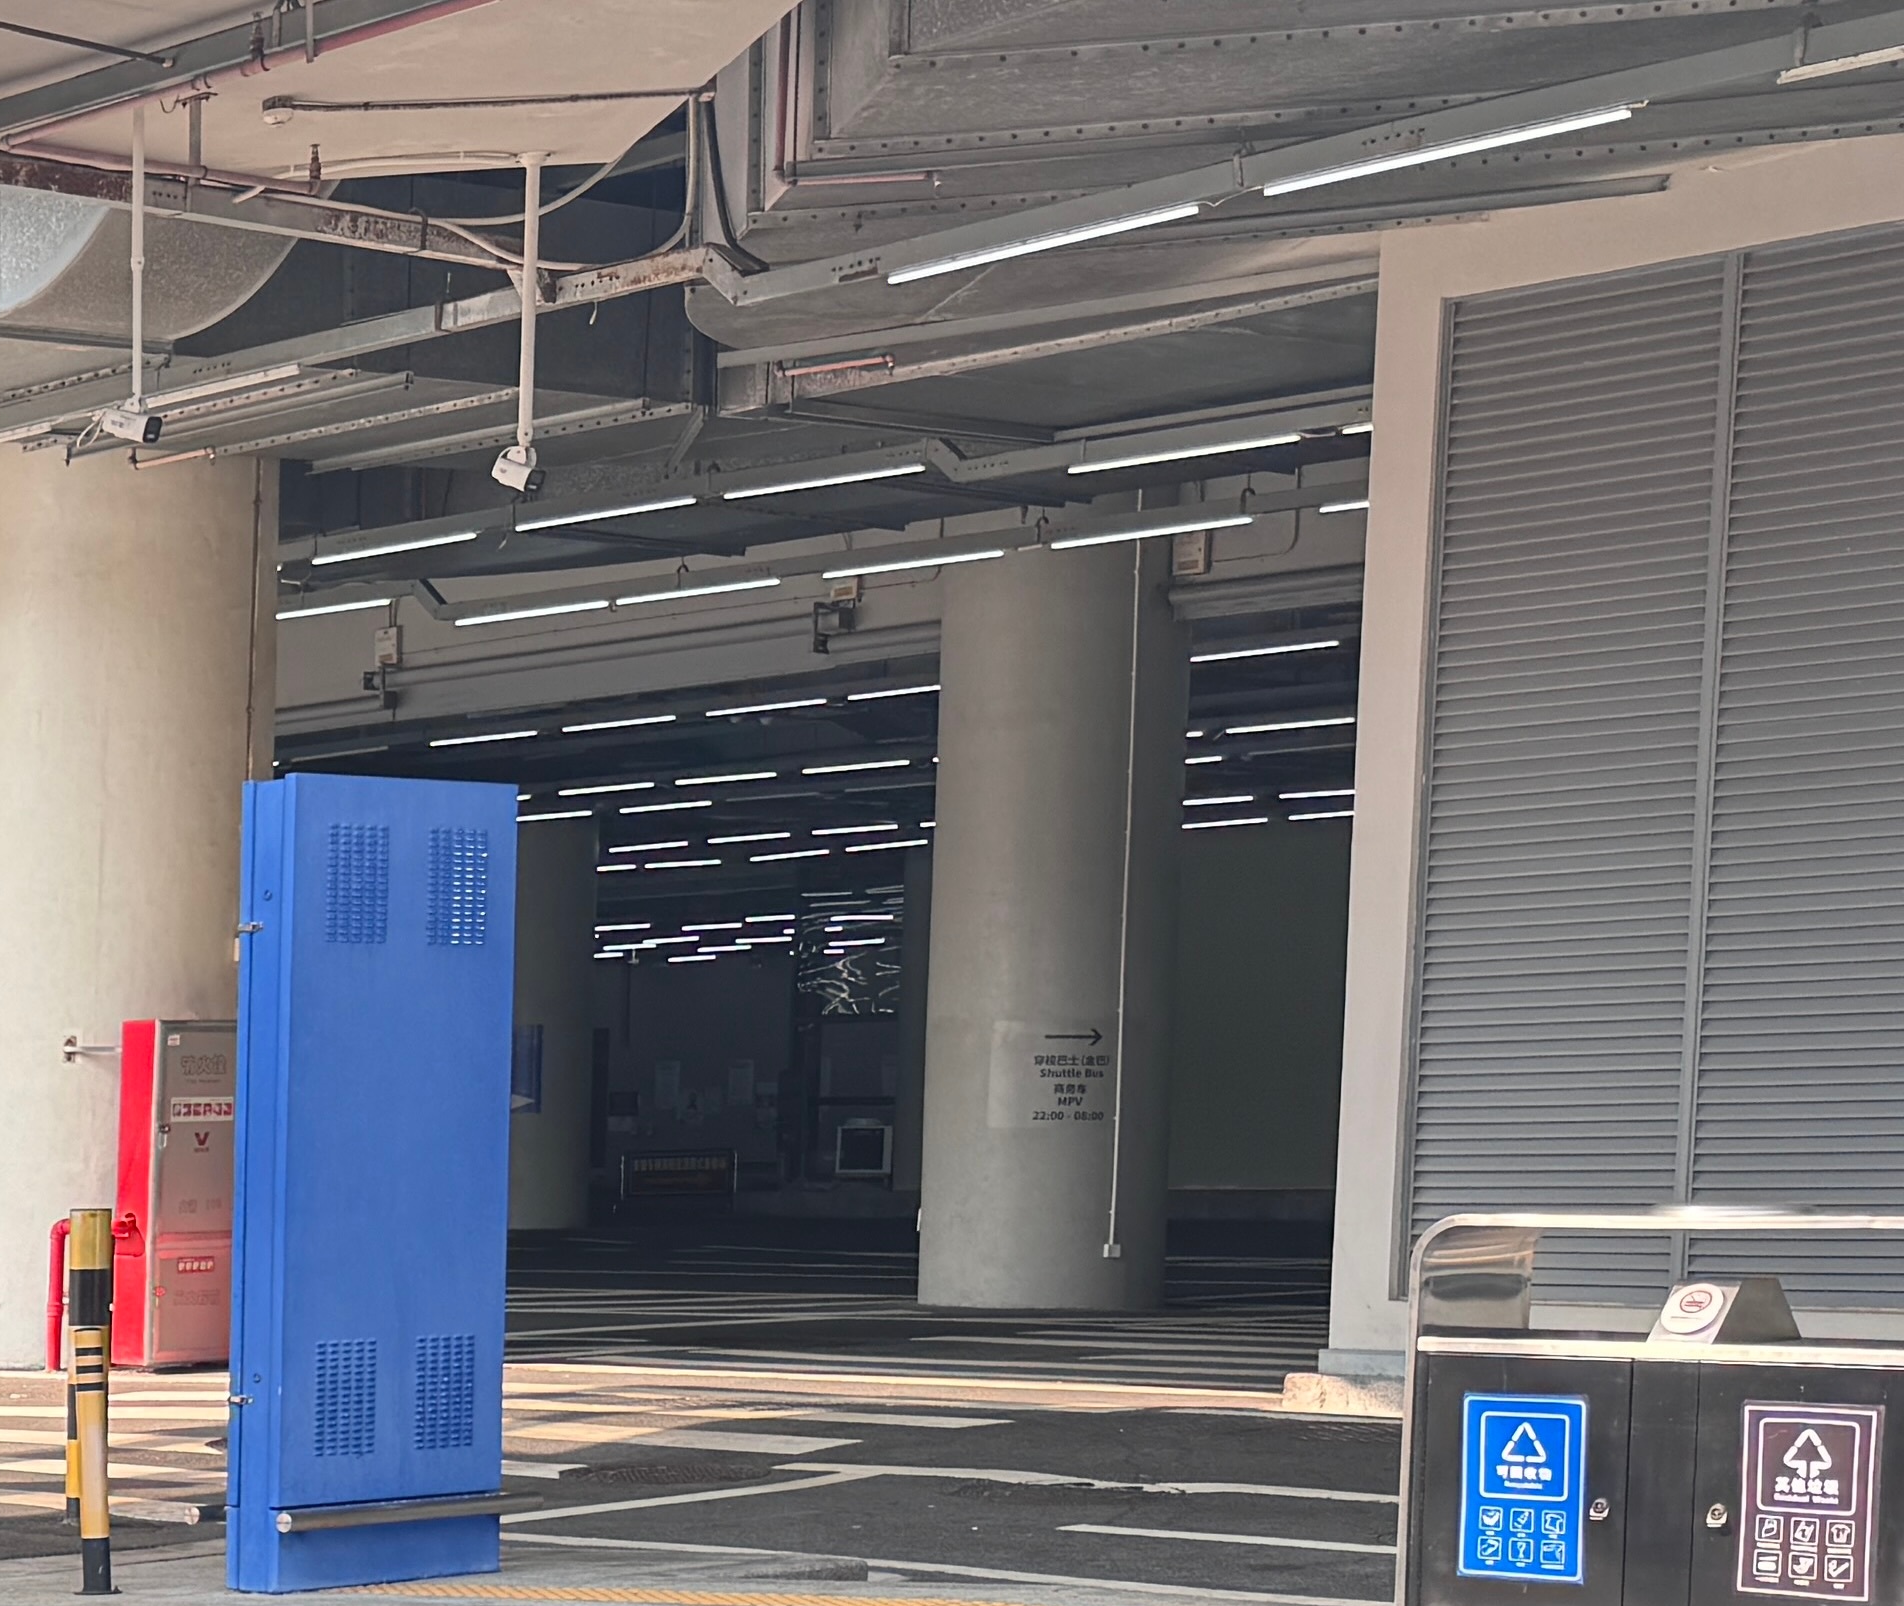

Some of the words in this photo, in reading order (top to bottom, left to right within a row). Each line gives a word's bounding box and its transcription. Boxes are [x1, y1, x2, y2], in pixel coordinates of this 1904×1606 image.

[1040, 1068, 1082, 1078] Shuttle
[1085, 1069, 1104, 1078] Bus
[1054, 1083, 1087, 1094] 商务车
[1058, 1097, 1083, 1106] MPV
[1032, 1111, 1064, 1121] 22:00
[1074, 1111, 1105, 1121] 08:00
